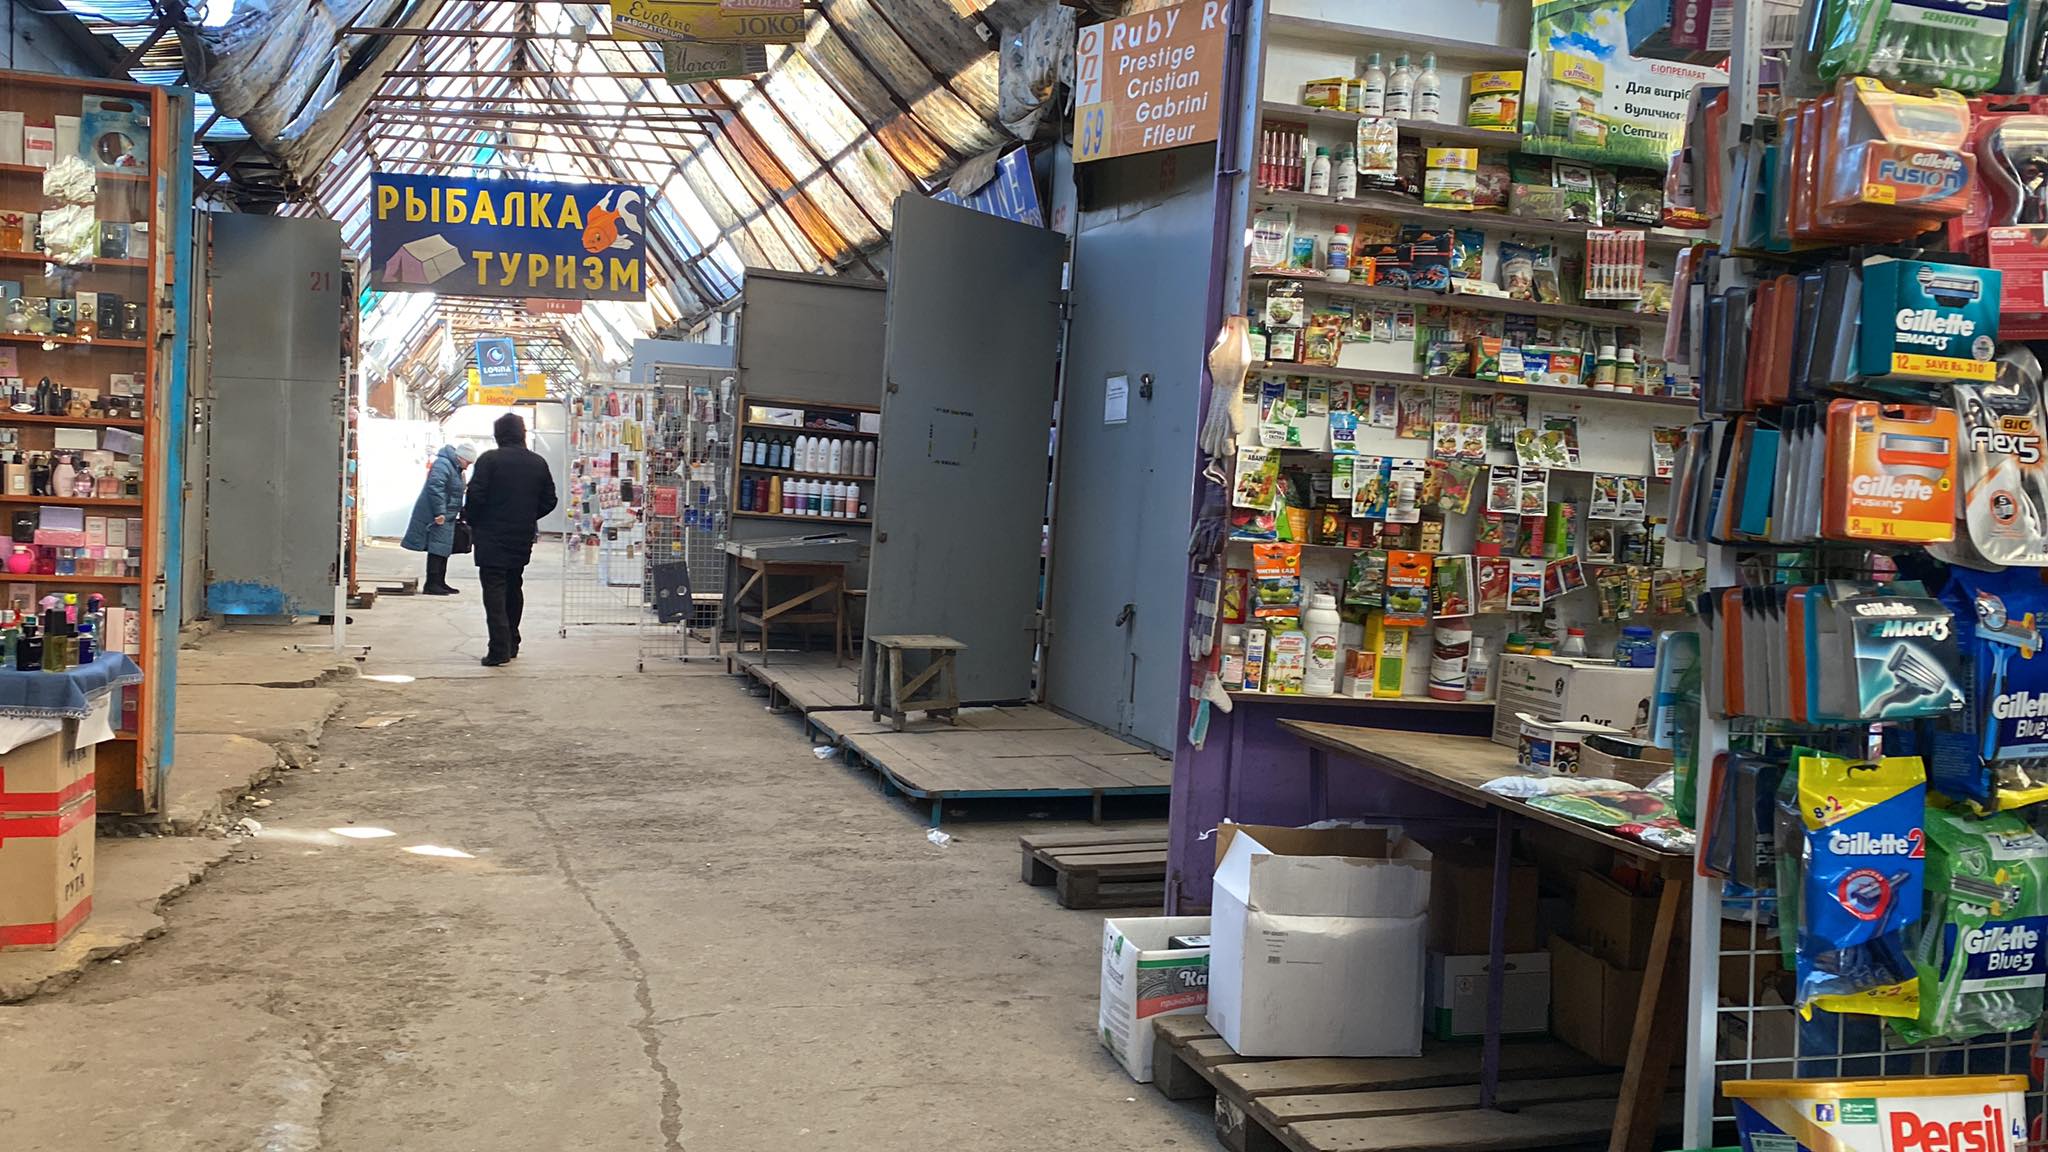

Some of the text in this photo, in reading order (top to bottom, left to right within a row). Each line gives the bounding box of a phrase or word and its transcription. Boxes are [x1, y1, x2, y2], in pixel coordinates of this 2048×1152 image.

[620, 16, 685, 40] LABORATORIUM
[629, 1, 691, 33] Eveline
[735, 17, 798, 35] JOKO
[1111, 8, 1180, 51] Ruby
[1920, 11, 1979, 28] SENSITIVE
[1119, 44, 1196, 76] Prestige
[1650, 63, 1706, 80] БІОПРЕПАРАТ
[1127, 69, 1200, 99] Cristian
[1626, 81, 1652, 95] Для
[1136, 92, 1208, 123] Gabrini
[1082, 108, 1105, 156] 69
[1142, 123, 1196, 147] Ffleur
[1911, 152, 1962, 172] Gillette
[377, 185, 584, 230] РЫБАЛКА
[310, 272, 331, 292] 21
[472, 250, 640, 293] ТУРИЗМ
[1896, 308, 1974, 337] Gillette
[1896, 333, 1951, 351] MACH3
[1896, 355, 1908, 369] 12
[1925, 359, 1949, 371] SAVE
[1966, 362, 1985, 374] 310
[1852, 474, 1934, 501] Gillette
[1881, 522, 1896, 536] XL
[1855, 603, 1918, 617] Gillette
[1873, 616, 1951, 641] MACH3
[1828, 827, 1926, 859] Gillette 2
[64, 873, 86, 901] РУТА
[1963, 925, 2038, 954] Gillette
[1987, 951, 2036, 972] Blue3
[1889, 1104, 2005, 1152] Persil
